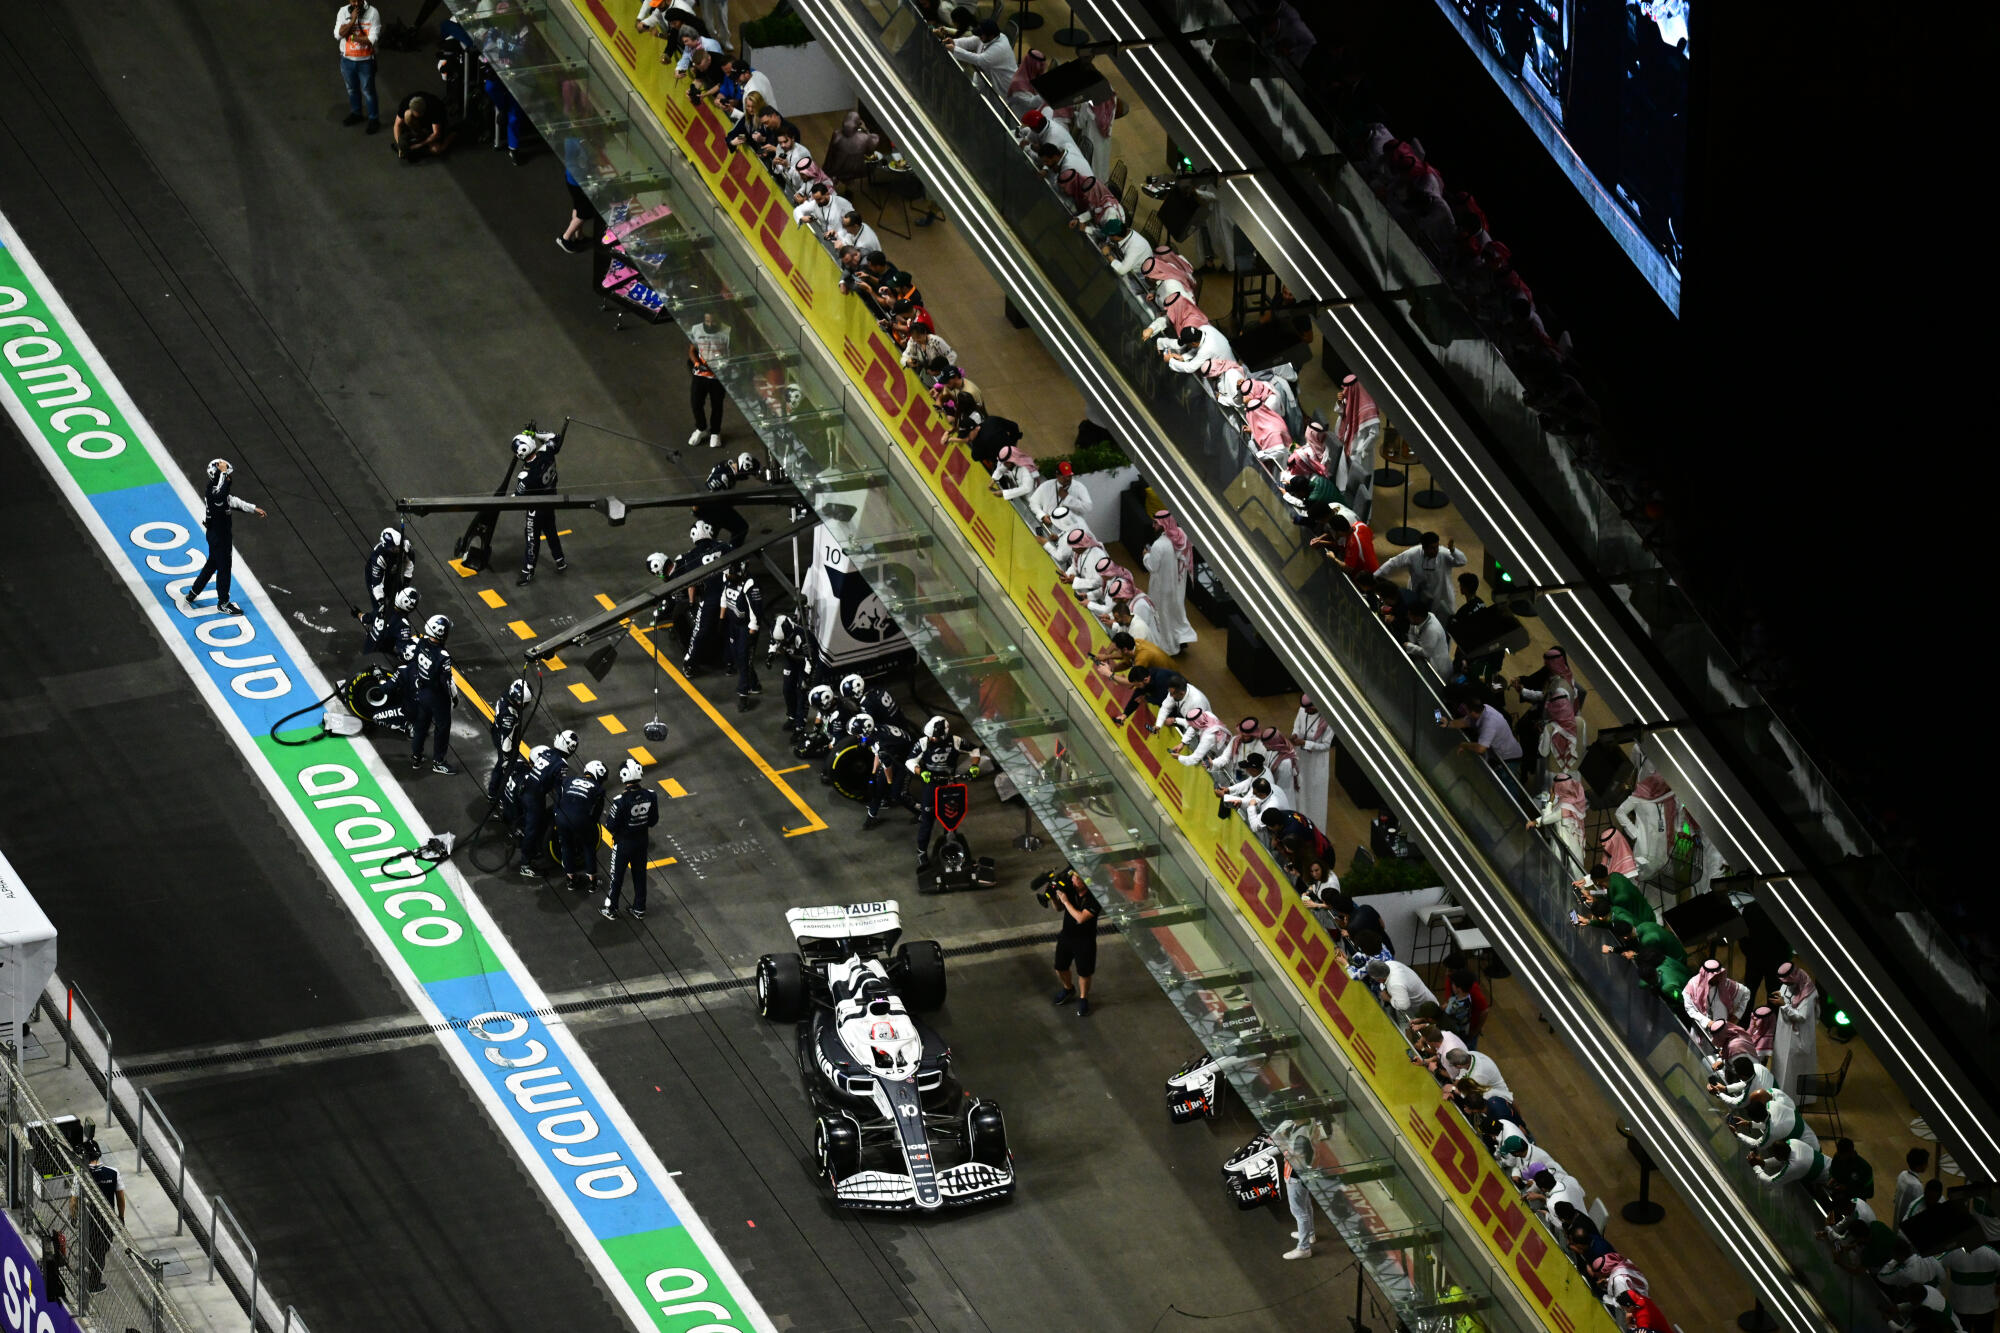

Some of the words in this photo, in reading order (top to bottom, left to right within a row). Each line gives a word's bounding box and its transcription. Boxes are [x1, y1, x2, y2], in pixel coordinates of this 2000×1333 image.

[685, 97, 793, 277] DHL
[863, 332, 975, 522] DHL
[129, 521, 292, 700] aramco
[825, 545, 842, 565] 10
[1047, 582, 1162, 778] DHL
[298, 763, 463, 947] aramco
[1237, 841, 1356, 1040] DHL
[467, 1011, 639, 1200] aramco
[898, 1103, 919, 1118] 10
[645, 1267, 743, 1333] ar
[1432, 1105, 1554, 1312] DHL
